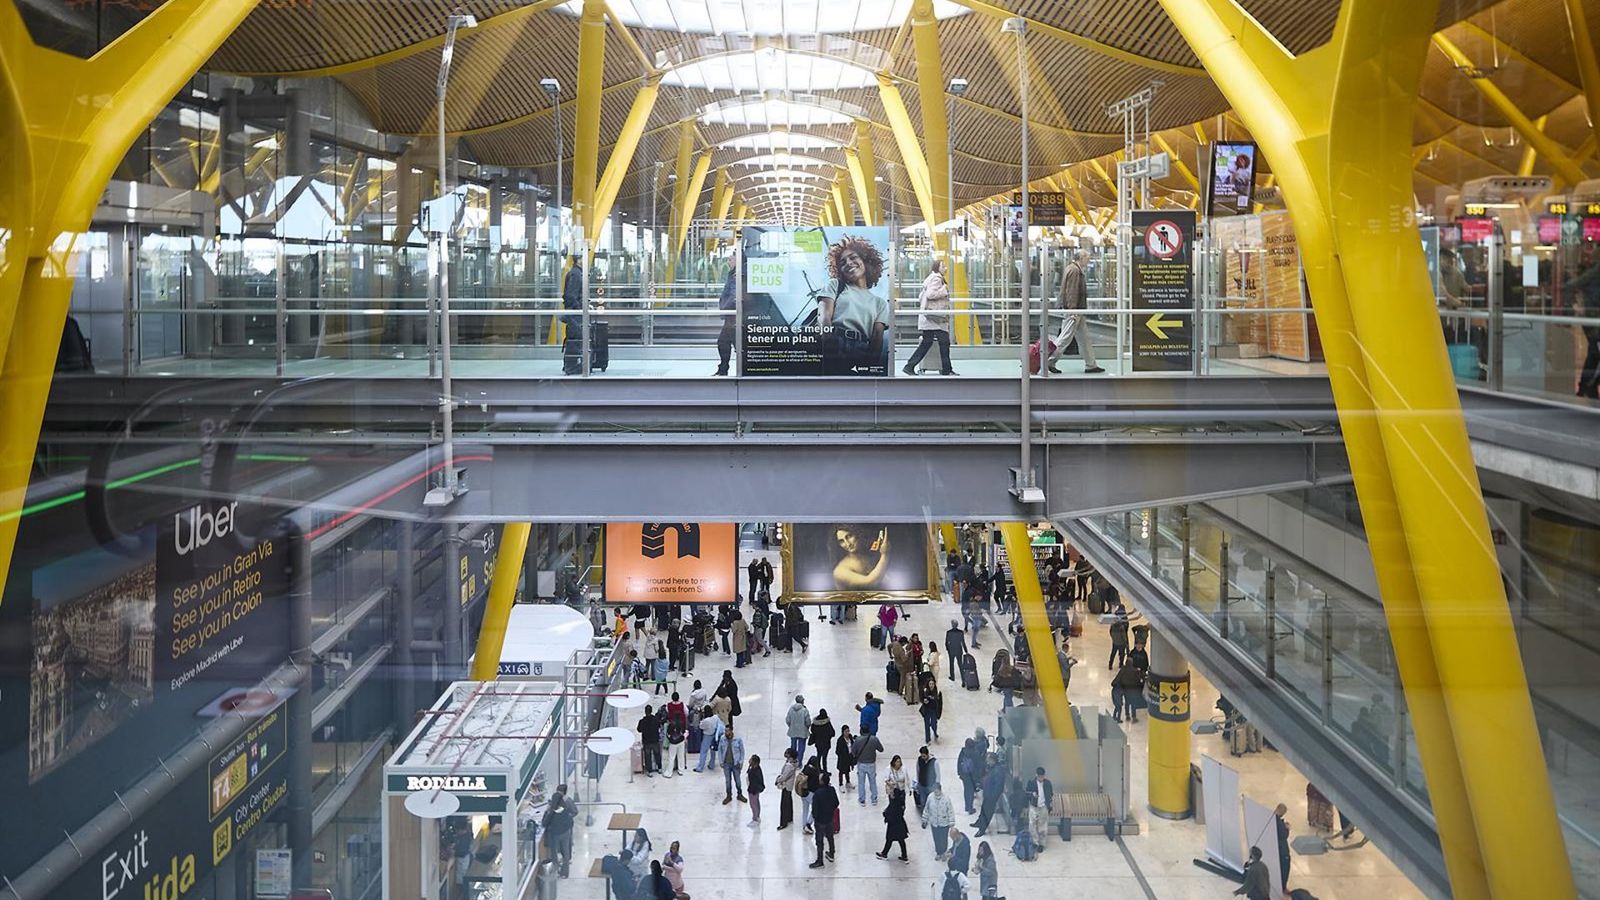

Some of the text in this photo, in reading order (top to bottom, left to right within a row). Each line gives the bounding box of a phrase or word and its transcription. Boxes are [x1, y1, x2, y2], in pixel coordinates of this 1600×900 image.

[752, 264, 784, 274] PLAN
[752, 276, 782, 286] PLUS
[747, 324, 788, 335] Siempre
[804, 324, 834, 335] mejor
[747, 335, 774, 343] tener
[792, 334, 817, 345] plan.
[175, 501, 238, 555] Uber
[173, 539, 273, 609] See you in Gran Vía
[672, 577, 689, 585] here
[690, 577, 699, 585] to
[678, 585, 696, 593] from
[172, 571, 261, 634] See you in Retiro
[171, 591, 262, 659] See you in Colón
[171, 635, 244, 691] Explore Madrid with Uber
[213, 777, 230, 808] T4
[407, 776, 487, 790] RODILLA
[235, 782, 270, 823] City Center
[236, 779, 287, 840] Centro Ciudad
[102, 830, 148, 900] Exit
